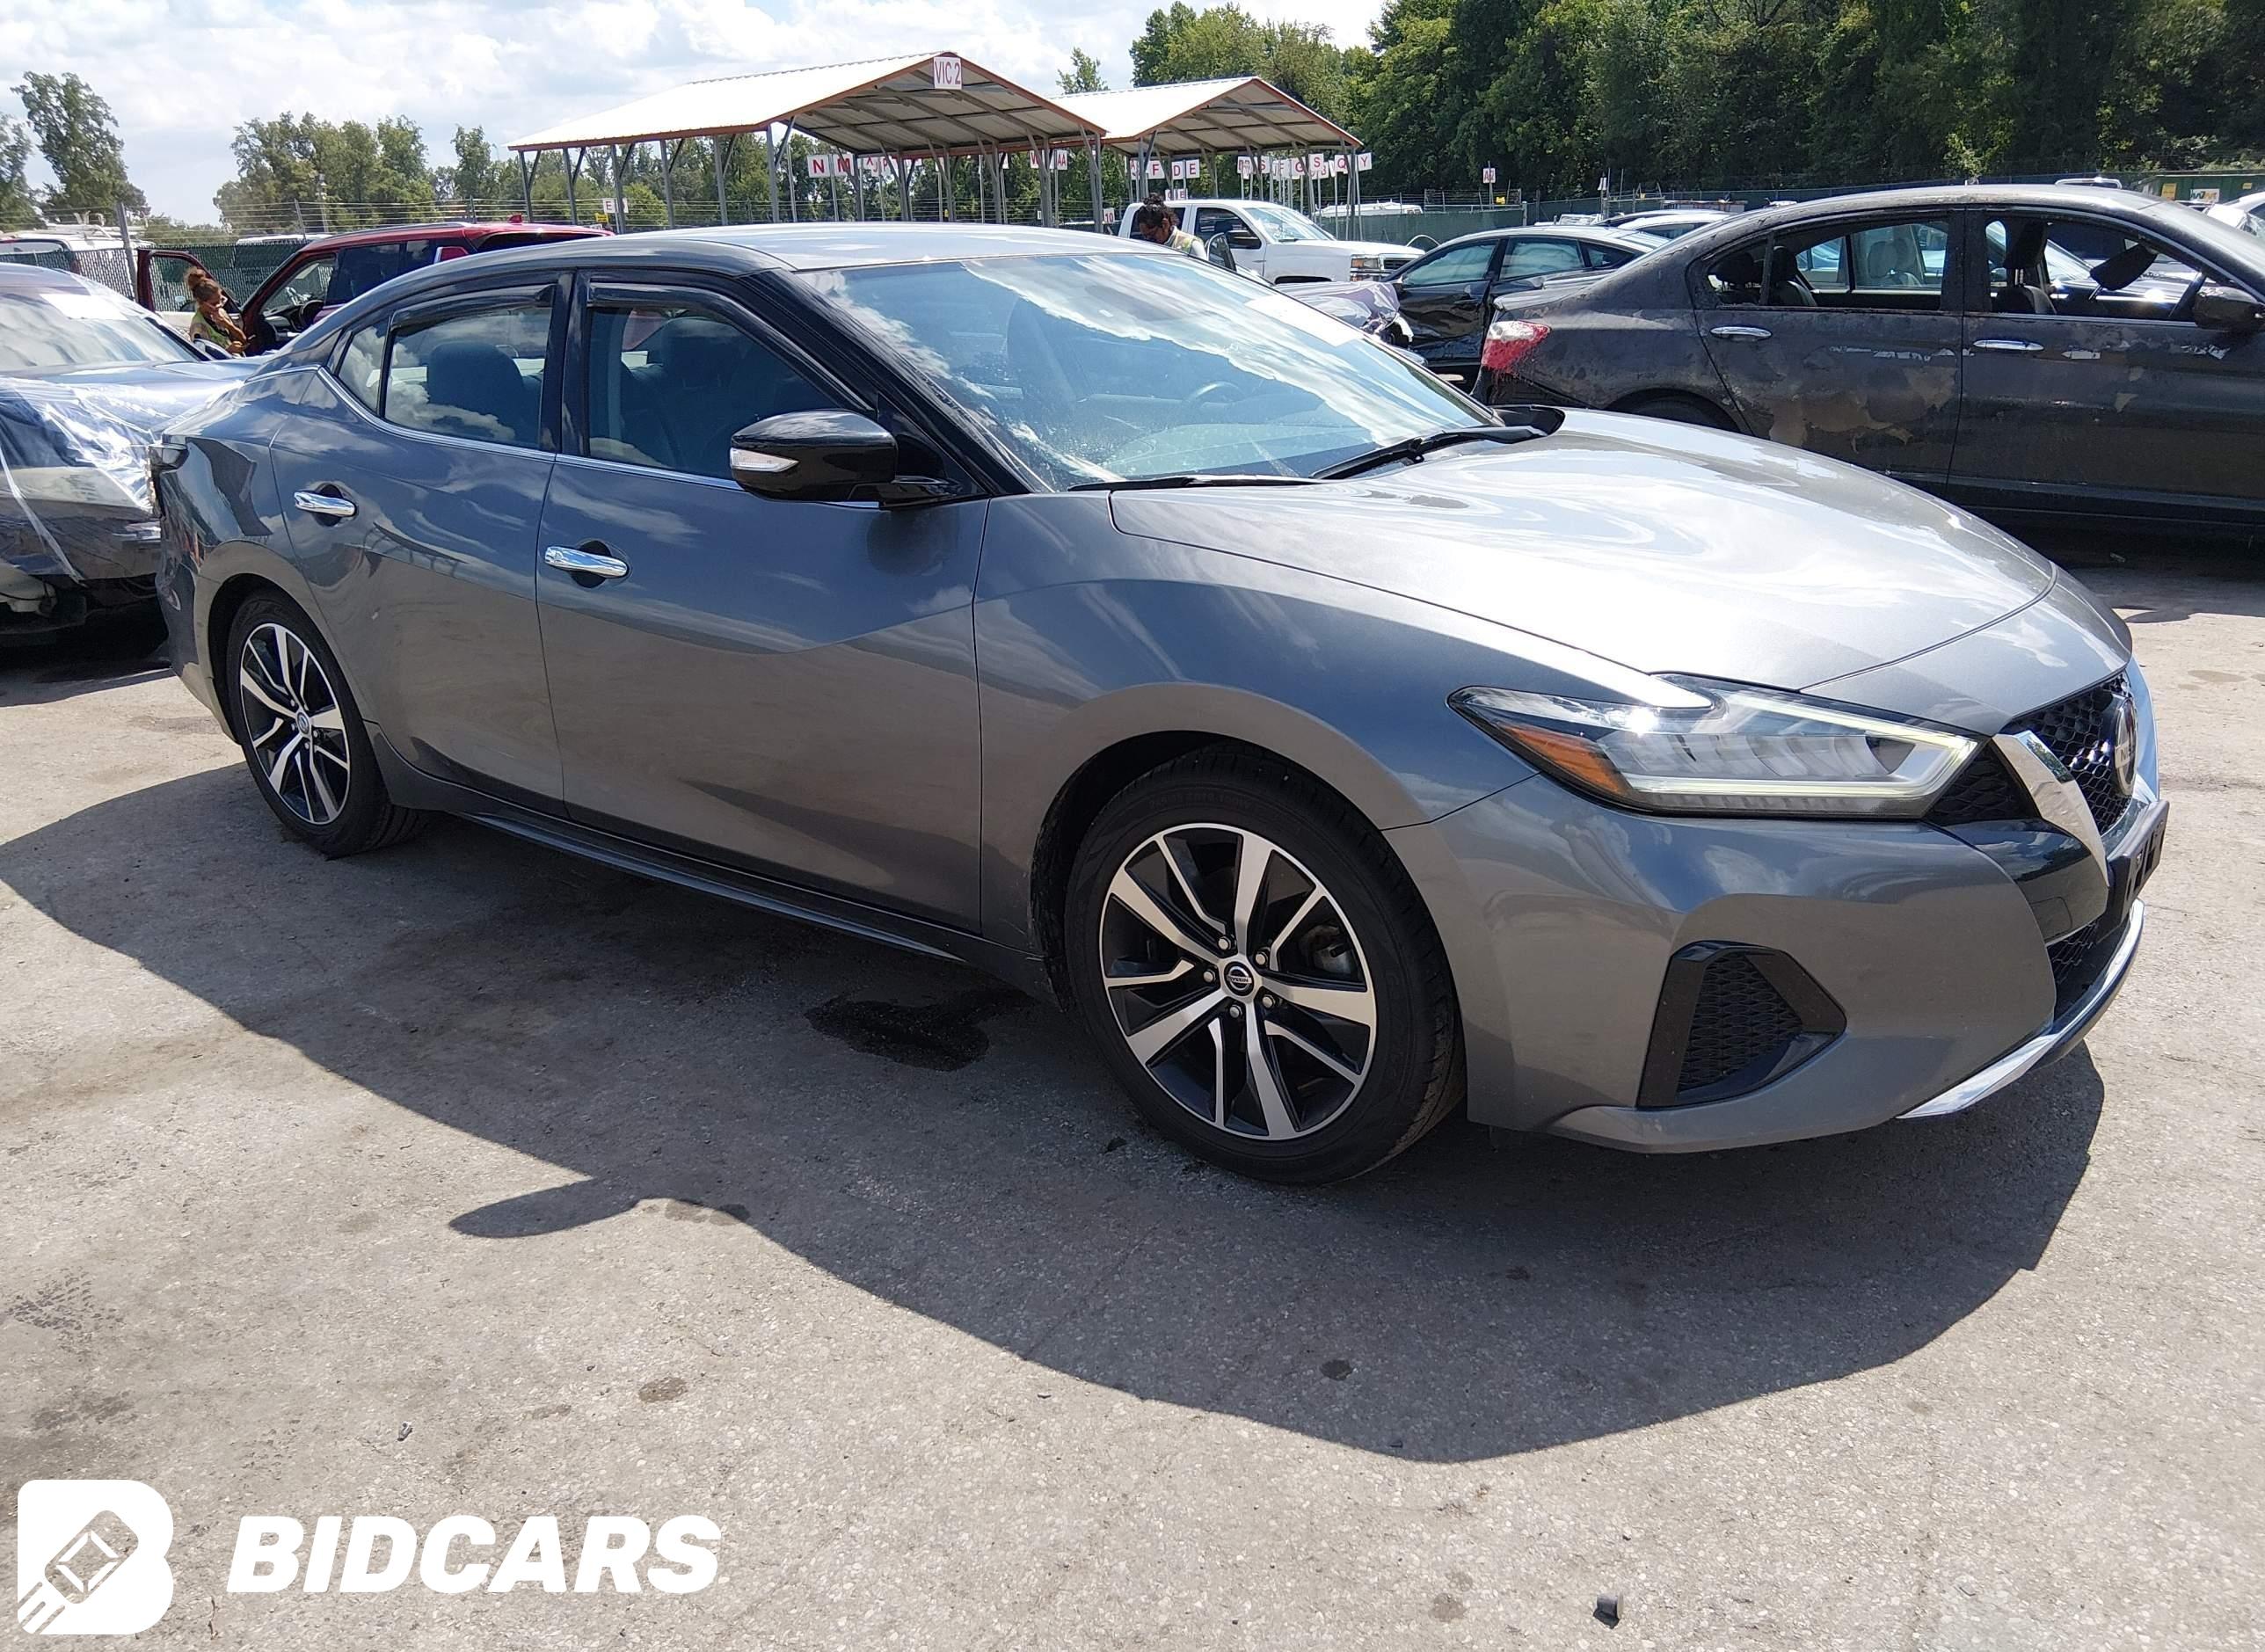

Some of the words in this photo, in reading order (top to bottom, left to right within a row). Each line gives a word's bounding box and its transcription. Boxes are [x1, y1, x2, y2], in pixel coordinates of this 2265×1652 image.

[935, 61, 952, 84] VIC
[954, 62, 961, 84] 2
[812, 159, 825, 173] N
[837, 157, 851, 172] M
[1058, 154, 1067, 167] AA
[1314, 156, 1321, 168] S
[1337, 158, 1346, 169] Q
[1360, 156, 1368, 167] Y
[1152, 164, 1160, 176] F
[1173, 164, 1181, 177] D
[1189, 163, 1197, 175] E
[606, 200, 613, 210] E
[1105, 213, 1113, 223] 10
